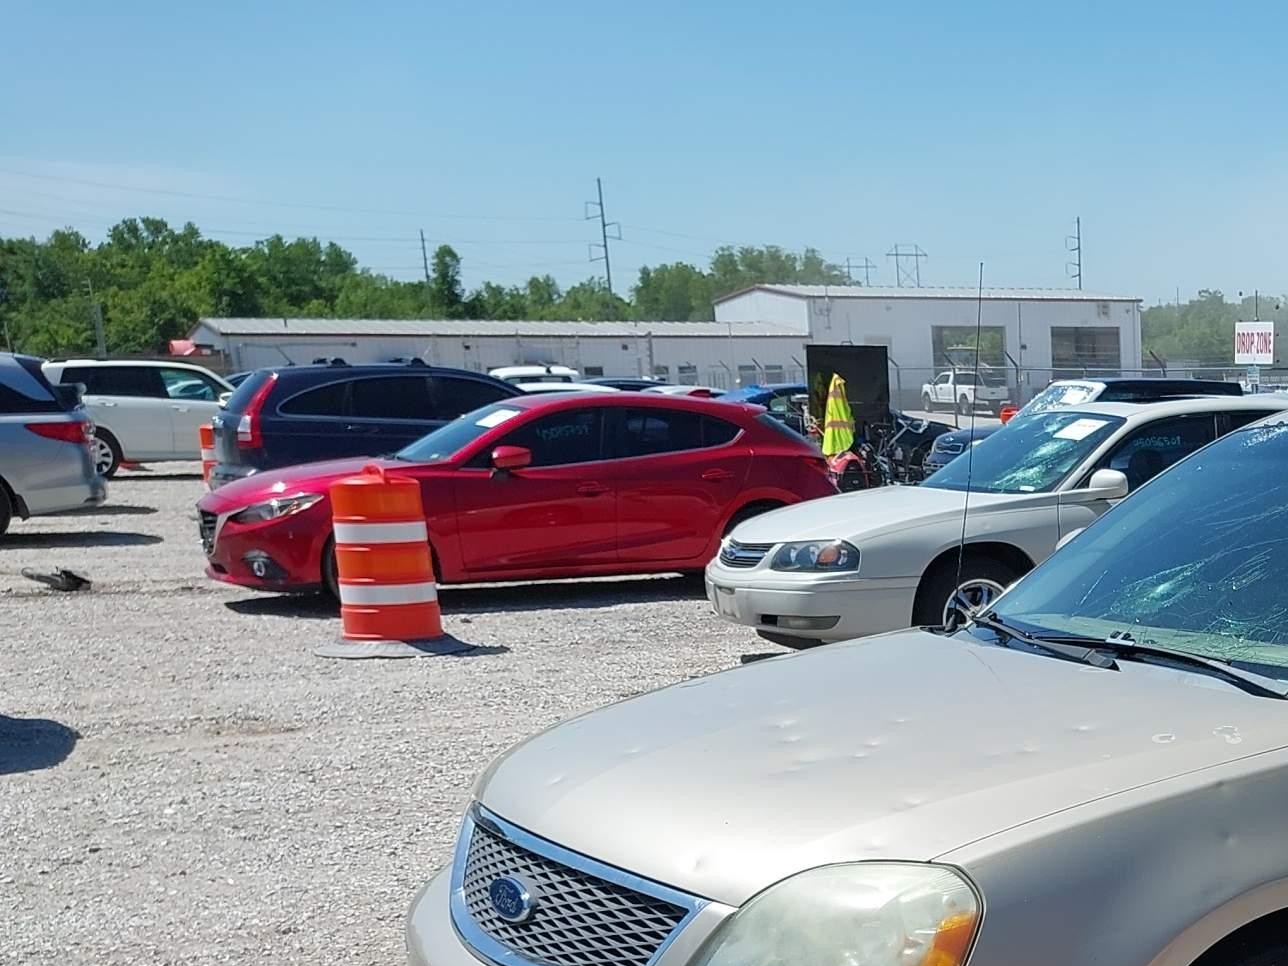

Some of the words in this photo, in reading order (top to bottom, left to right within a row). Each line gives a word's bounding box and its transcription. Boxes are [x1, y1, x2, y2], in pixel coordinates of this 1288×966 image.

[1237, 332, 1255, 354] DROP
[1256, 332, 1272, 354] ZONE
[494, 883, 519, 914] Ford
